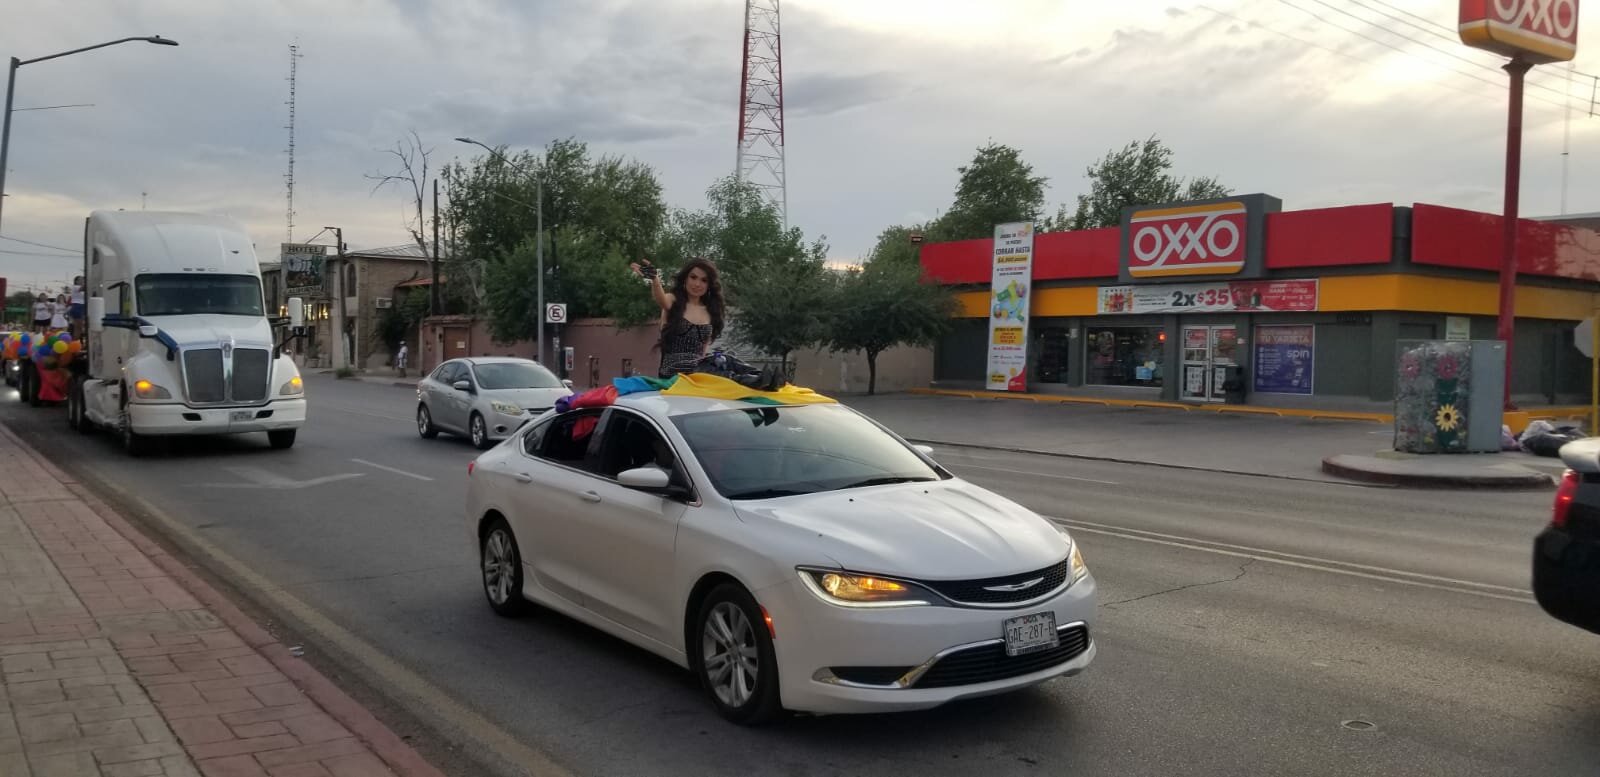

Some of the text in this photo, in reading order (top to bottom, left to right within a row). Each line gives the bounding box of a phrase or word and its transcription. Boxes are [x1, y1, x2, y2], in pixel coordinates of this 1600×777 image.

[1133, 213, 1240, 267] OXXO
[288, 246, 320, 254] HOTEL
[1287, 349, 1310, 360] spin
